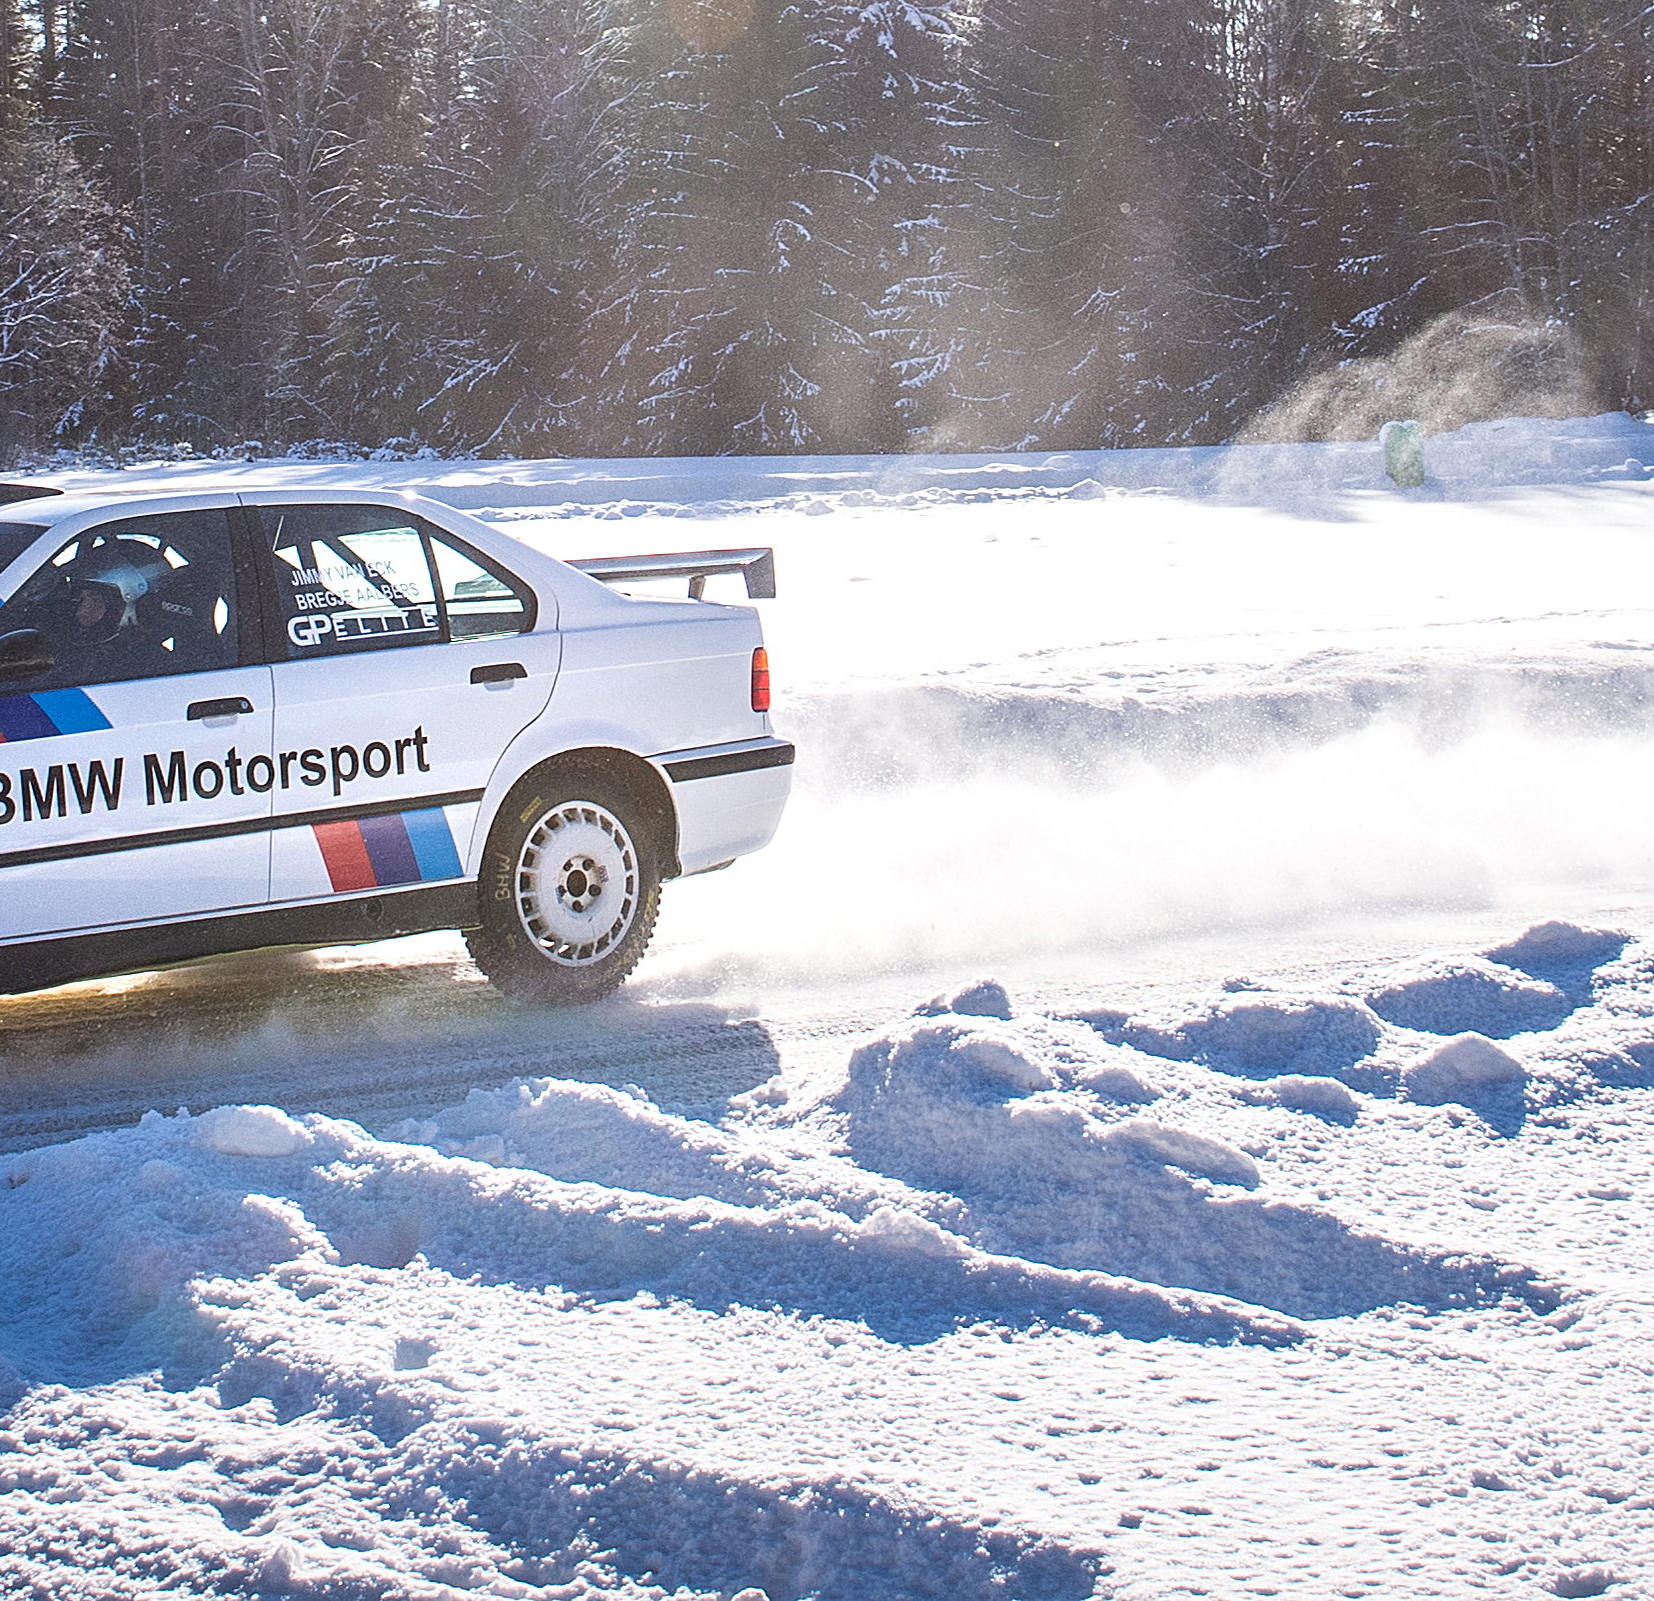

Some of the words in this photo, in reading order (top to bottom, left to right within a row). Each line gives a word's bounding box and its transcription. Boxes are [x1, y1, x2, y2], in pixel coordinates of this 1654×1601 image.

[291, 567, 333, 586] JIMMY
[334, 563, 366, 580] VAN
[367, 560, 396, 578] ECK
[295, 589, 351, 610] BREGJE
[357, 582, 420, 603] AALBERS
[144, 725, 431, 807] Motorsport
